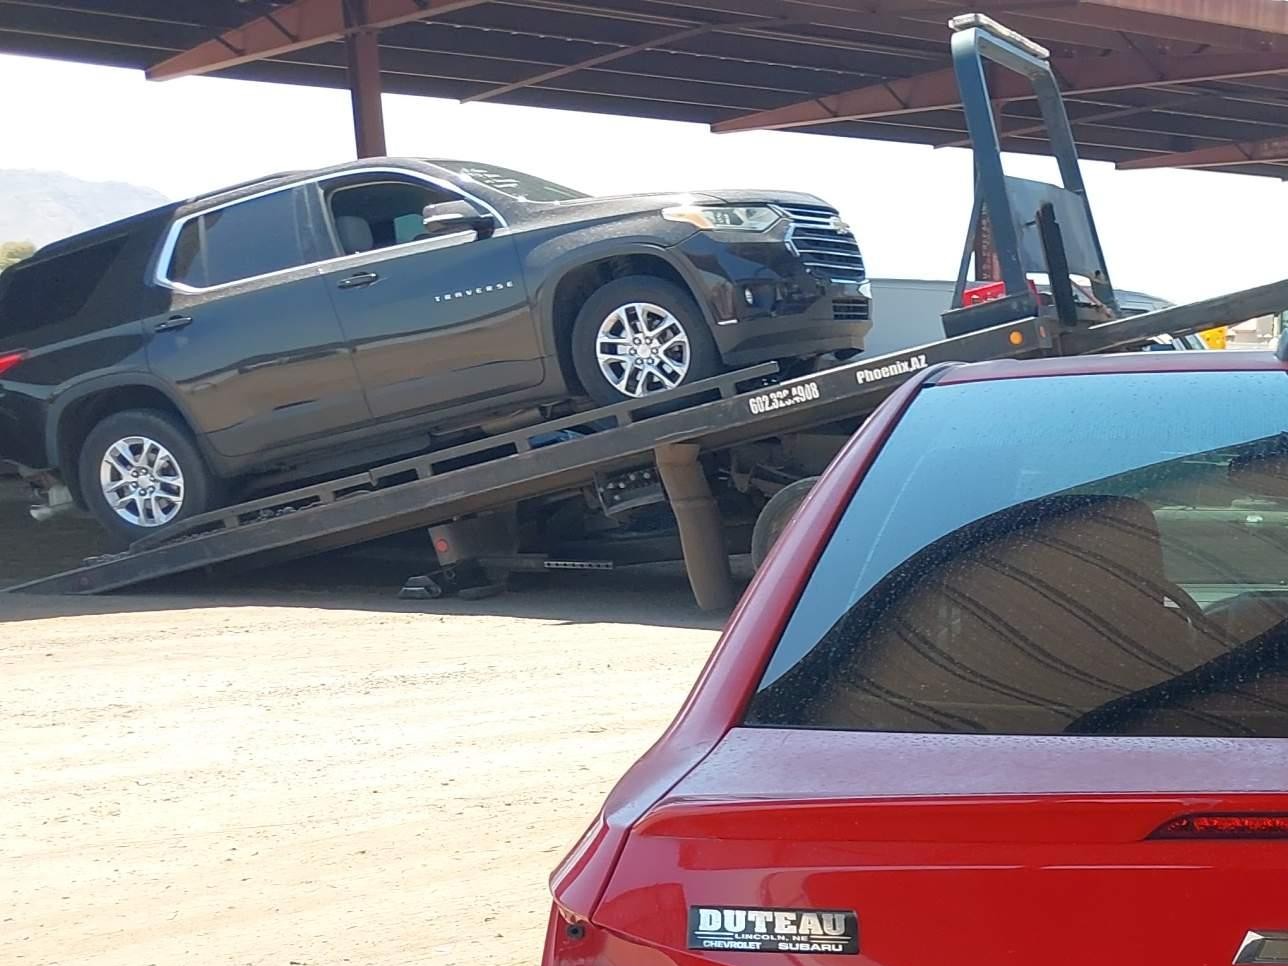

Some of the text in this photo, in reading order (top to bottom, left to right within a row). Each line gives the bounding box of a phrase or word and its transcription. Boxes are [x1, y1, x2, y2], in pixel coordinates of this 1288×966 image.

[434, 280, 514, 303] TRAVERSE
[698, 908, 846, 935] DUTEAU
[703, 940, 843, 952] CHEVROLET SUBARU
